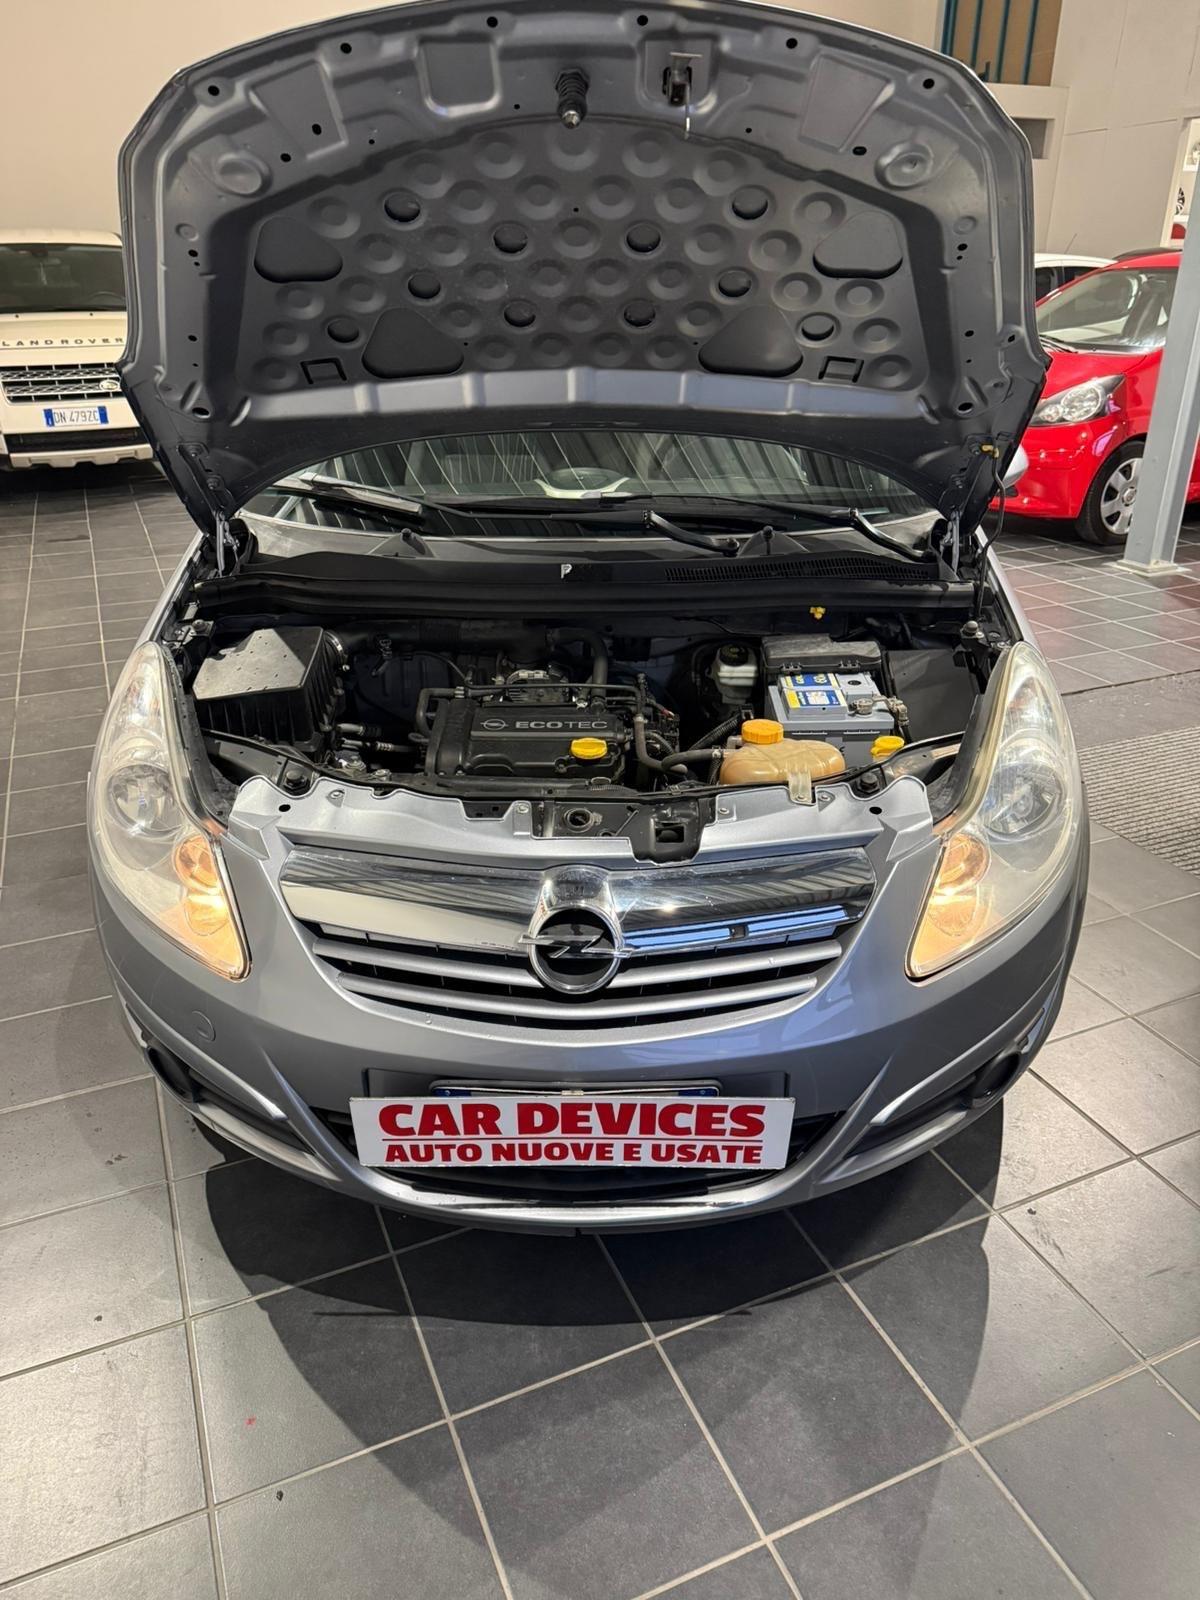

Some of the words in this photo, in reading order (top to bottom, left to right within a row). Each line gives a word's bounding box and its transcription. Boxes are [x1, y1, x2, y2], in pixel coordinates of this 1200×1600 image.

[53, 411, 67, 424] DN
[515, 720, 608, 730] ECOTEC
[378, 1103, 501, 1137] CAR
[516, 1103, 765, 1138] DEVICES
[385, 1143, 483, 1163] AUTO
[491, 1142, 614, 1163] NUOVE
[623, 1143, 641, 1162] E
[650, 1143, 762, 1164] USATE
